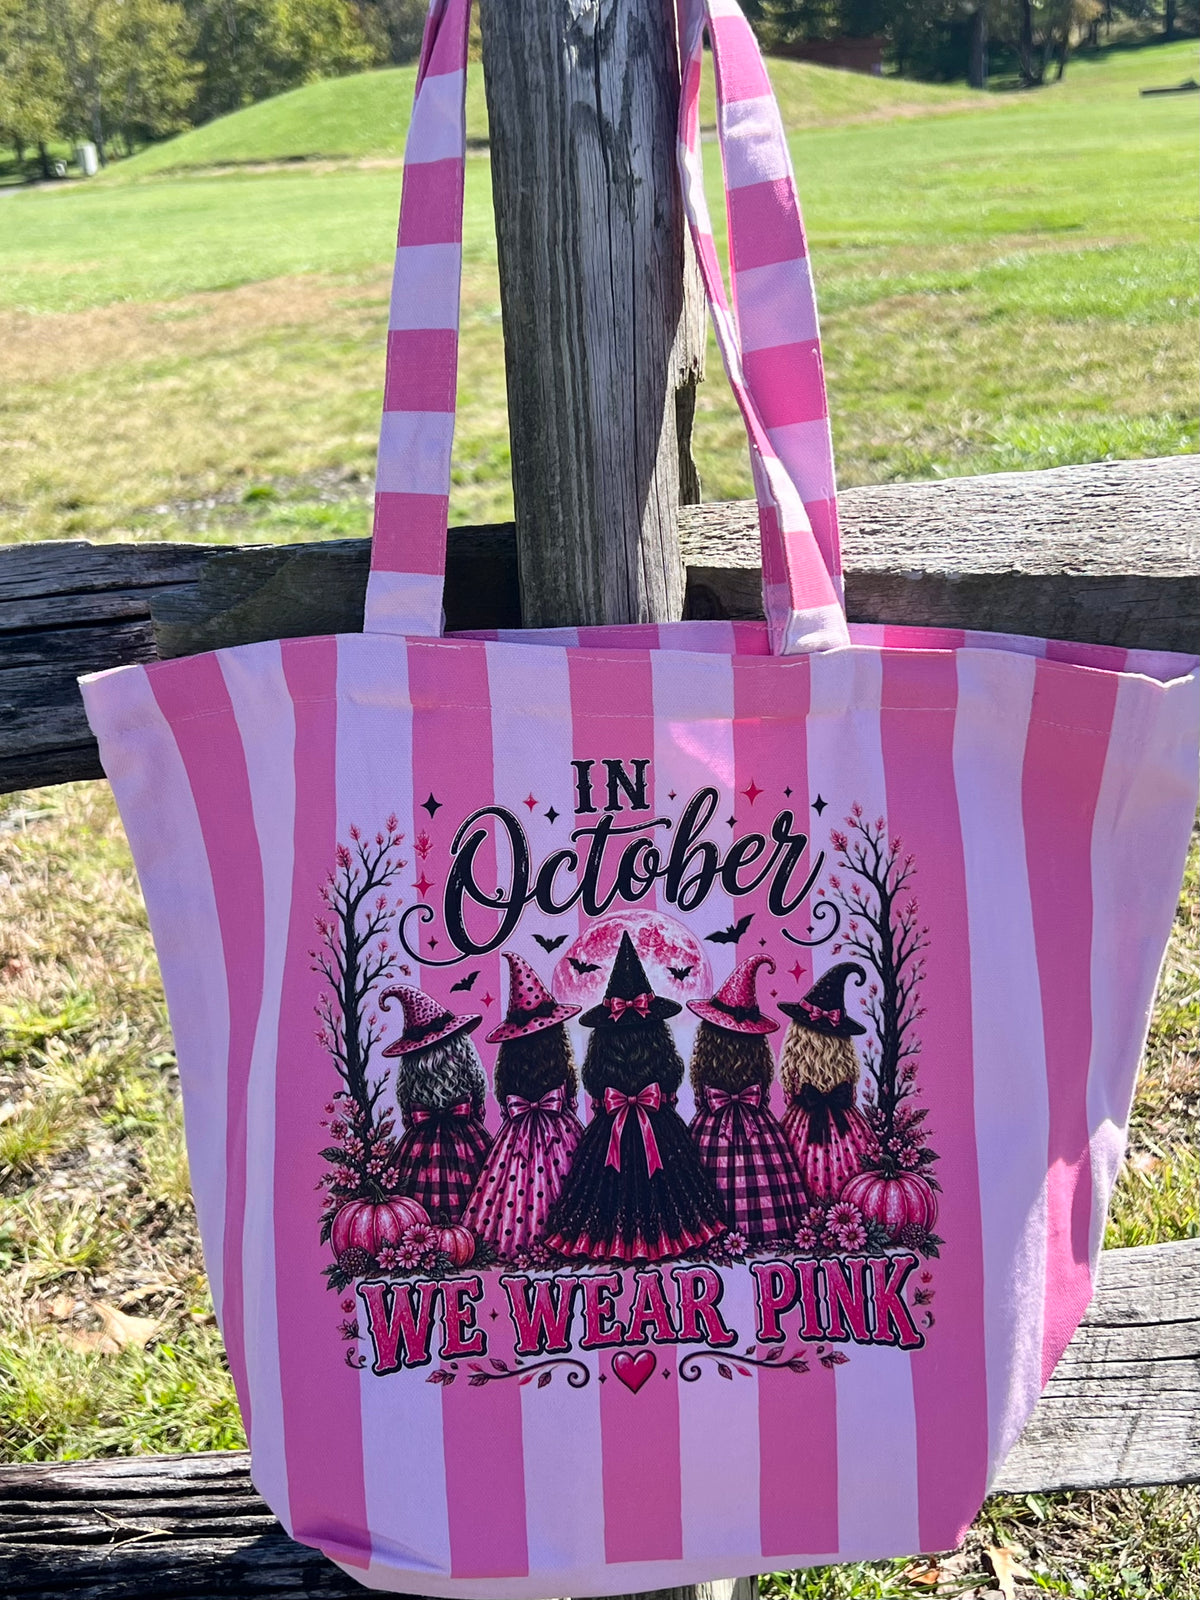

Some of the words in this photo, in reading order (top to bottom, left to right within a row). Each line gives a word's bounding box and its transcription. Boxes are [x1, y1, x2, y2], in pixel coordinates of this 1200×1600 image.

[570, 759, 651, 814] IN
[444, 787, 825, 956] October
[357, 1275, 485, 1376] WE
[500, 1264, 737, 1356] WEAR
[751, 1254, 926, 1350] PINK
